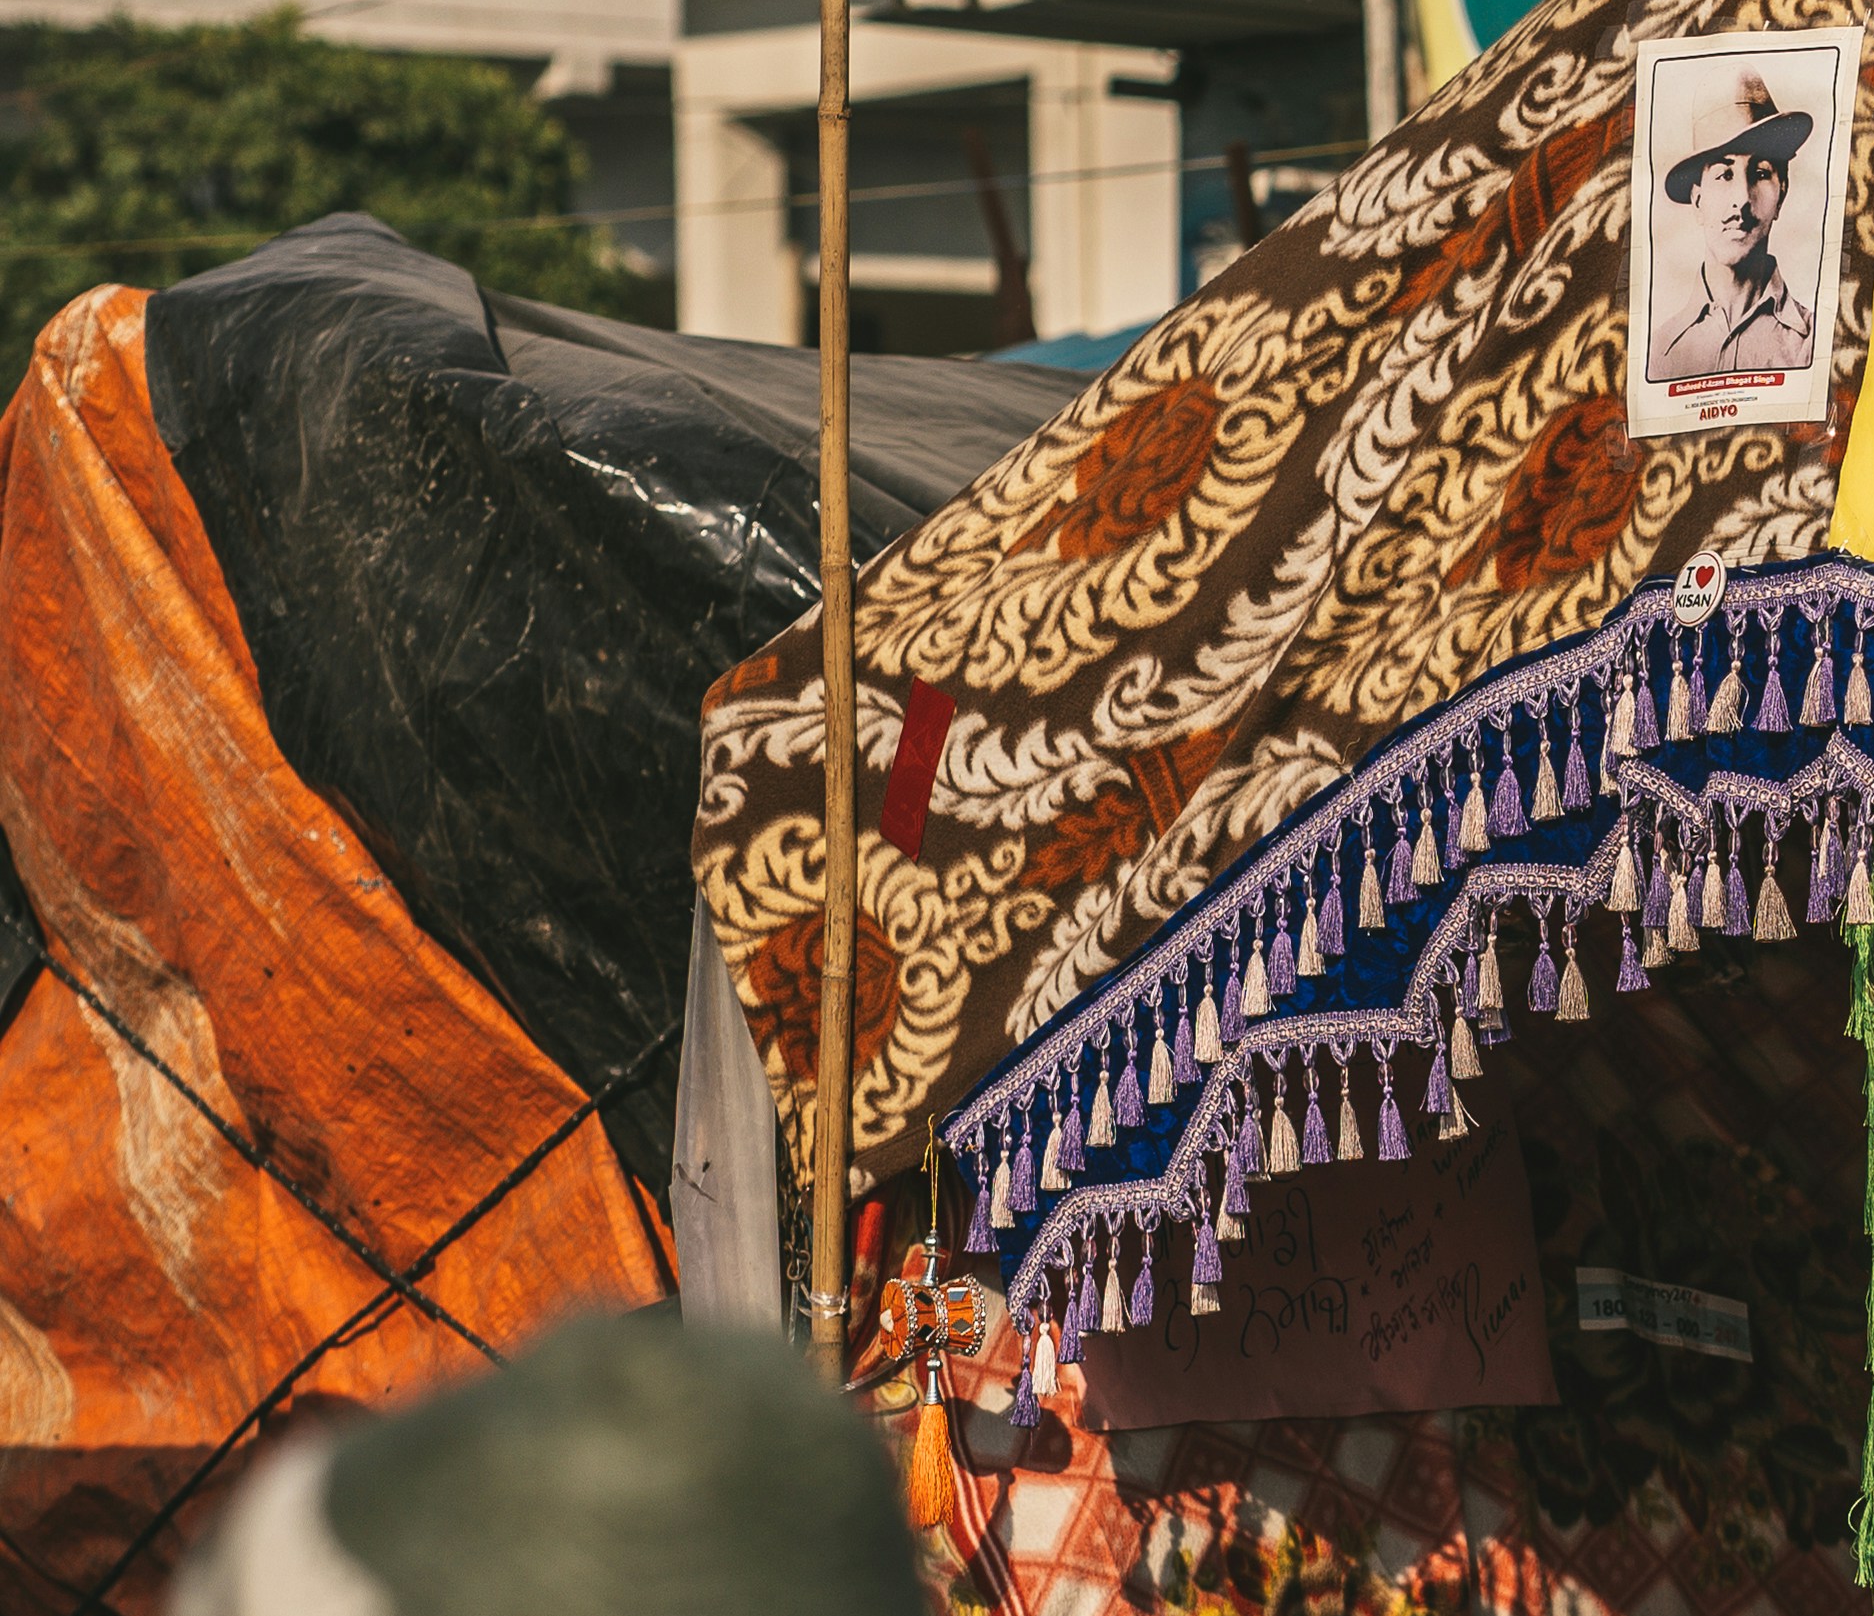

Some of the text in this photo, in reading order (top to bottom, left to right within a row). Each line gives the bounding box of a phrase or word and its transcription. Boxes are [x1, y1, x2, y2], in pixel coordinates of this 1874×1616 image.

[1753, 375, 1776, 385] Singh
[1699, 404, 1738, 420] AIDYO
[1682, 566, 1696, 589] I
[1675, 593, 1711, 607] KISAN
